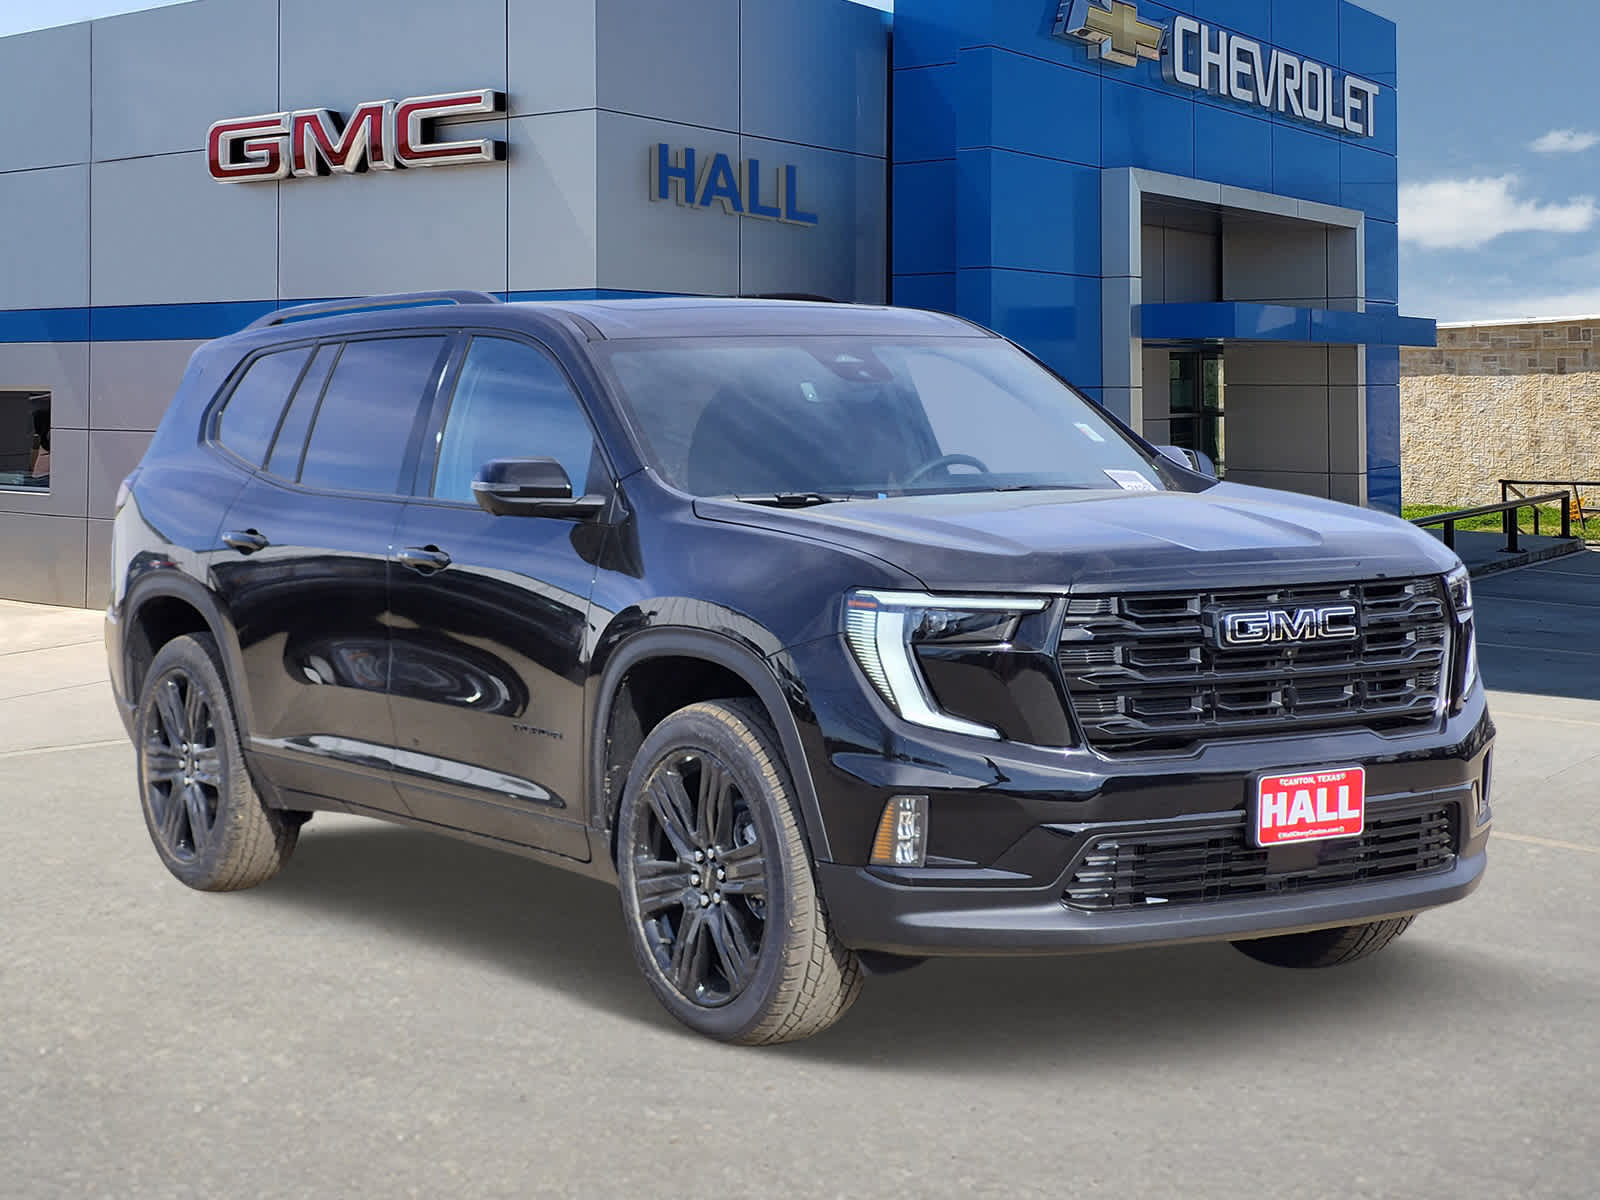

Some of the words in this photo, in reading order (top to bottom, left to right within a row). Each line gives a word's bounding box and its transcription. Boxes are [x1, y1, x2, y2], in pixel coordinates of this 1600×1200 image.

[1173, 15, 1379, 137] CHEVROLET
[205, 88, 500, 184] GMC
[654, 142, 818, 226] HALL
[1225, 606, 1357, 644] GMC
[1261, 785, 1361, 829] HALL
[1317, 773, 1341, 783] TEXAS
